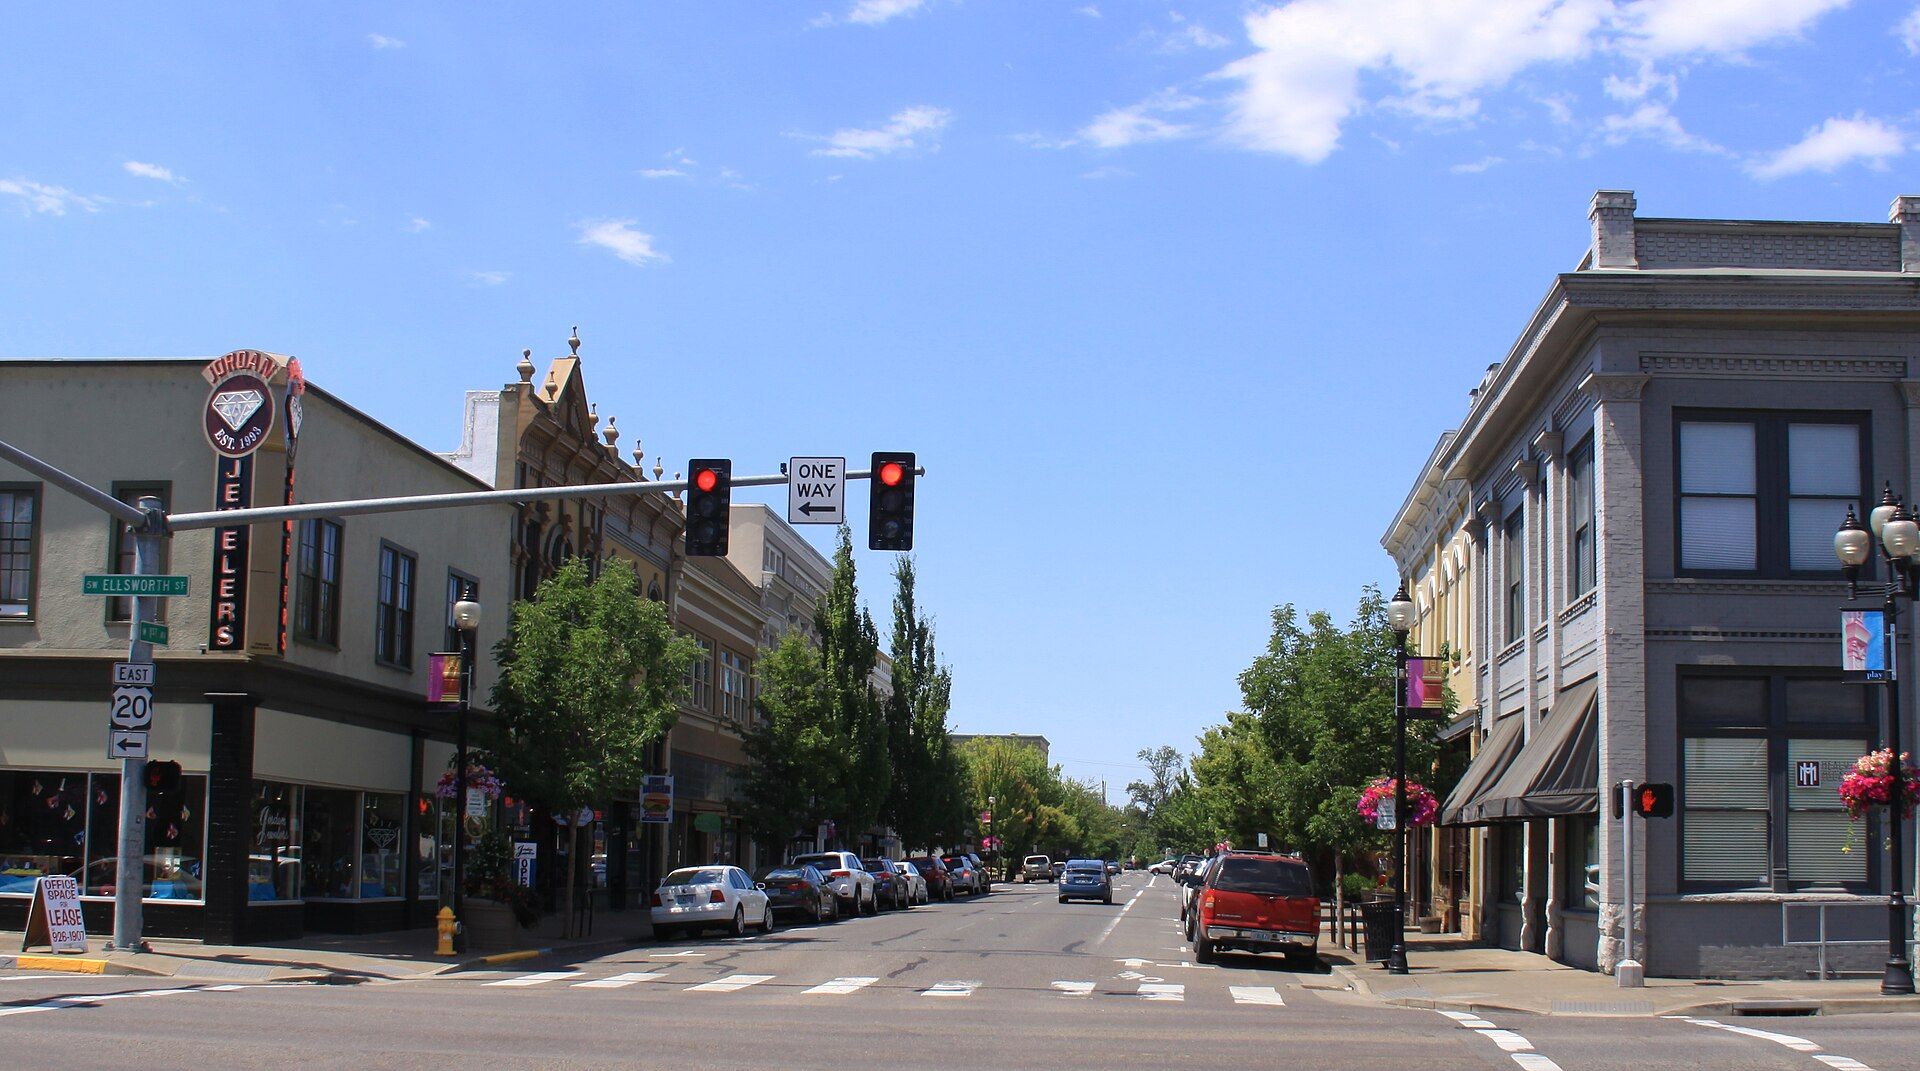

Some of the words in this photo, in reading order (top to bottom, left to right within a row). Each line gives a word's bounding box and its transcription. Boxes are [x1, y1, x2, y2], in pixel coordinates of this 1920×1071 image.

[208, 351, 278, 384] JORDAN
[214, 428, 236, 450] EST.
[239, 426, 262, 450] 1993
[799, 464, 836, 479] ONE
[797, 483, 836, 498] WAY
[215, 459, 241, 646] JEELERS
[86, 581, 98, 589] SW
[102, 579, 170, 591] ELLSWORTH
[175, 581, 186, 590] ST
[119, 666, 149, 681] EAST
[1866, 671, 1882, 680] play
[116, 695, 147, 719] 20
[520, 859, 528, 886] OPE
[44, 880, 76, 890] OFFICE
[47, 890, 76, 900] SPACE
[48, 909, 82, 926] LEASE
